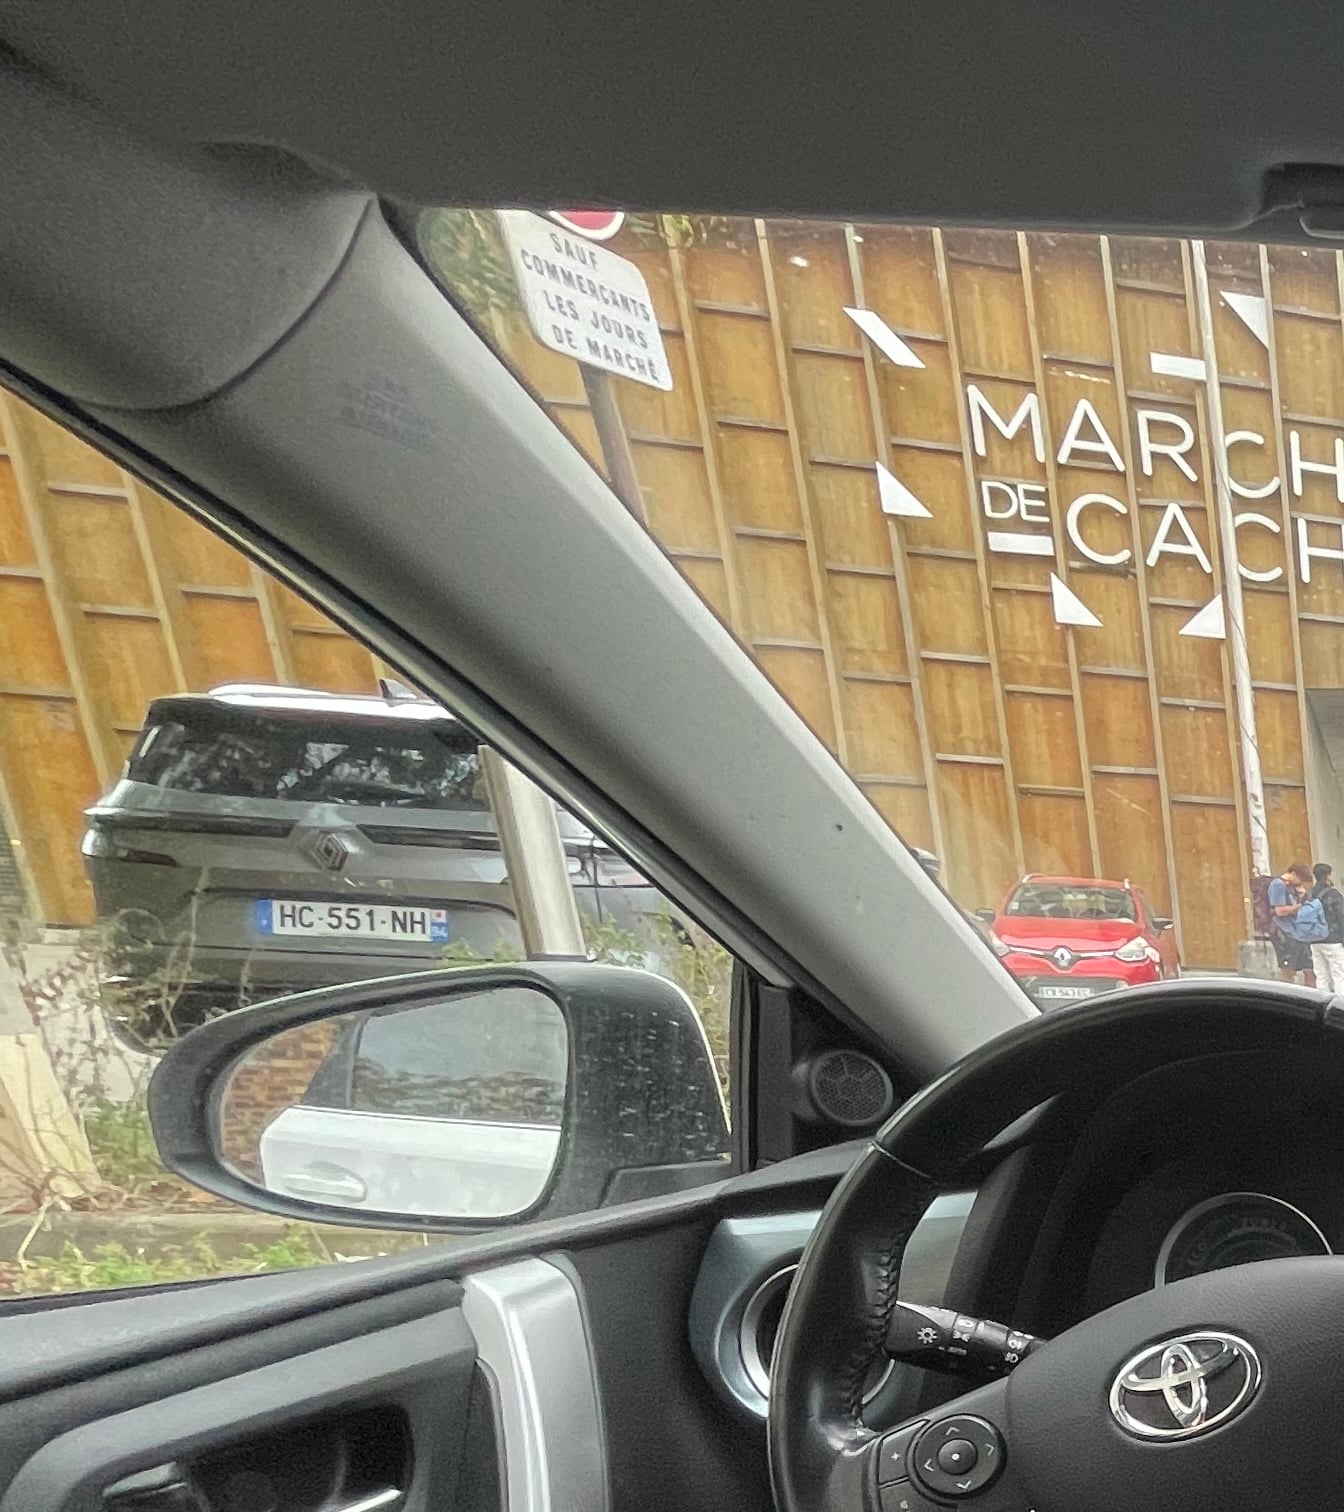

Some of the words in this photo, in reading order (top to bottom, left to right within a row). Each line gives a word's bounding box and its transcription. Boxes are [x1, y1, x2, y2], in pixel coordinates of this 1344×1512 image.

[550, 233, 598, 269] SAUF
[544, 289, 579, 320] LES
[590, 310, 648, 349] JOURS
[552, 324, 577, 349] DE
[980, 480, 1051, 523] DE
[279, 904, 426, 934] HC-551-NH
